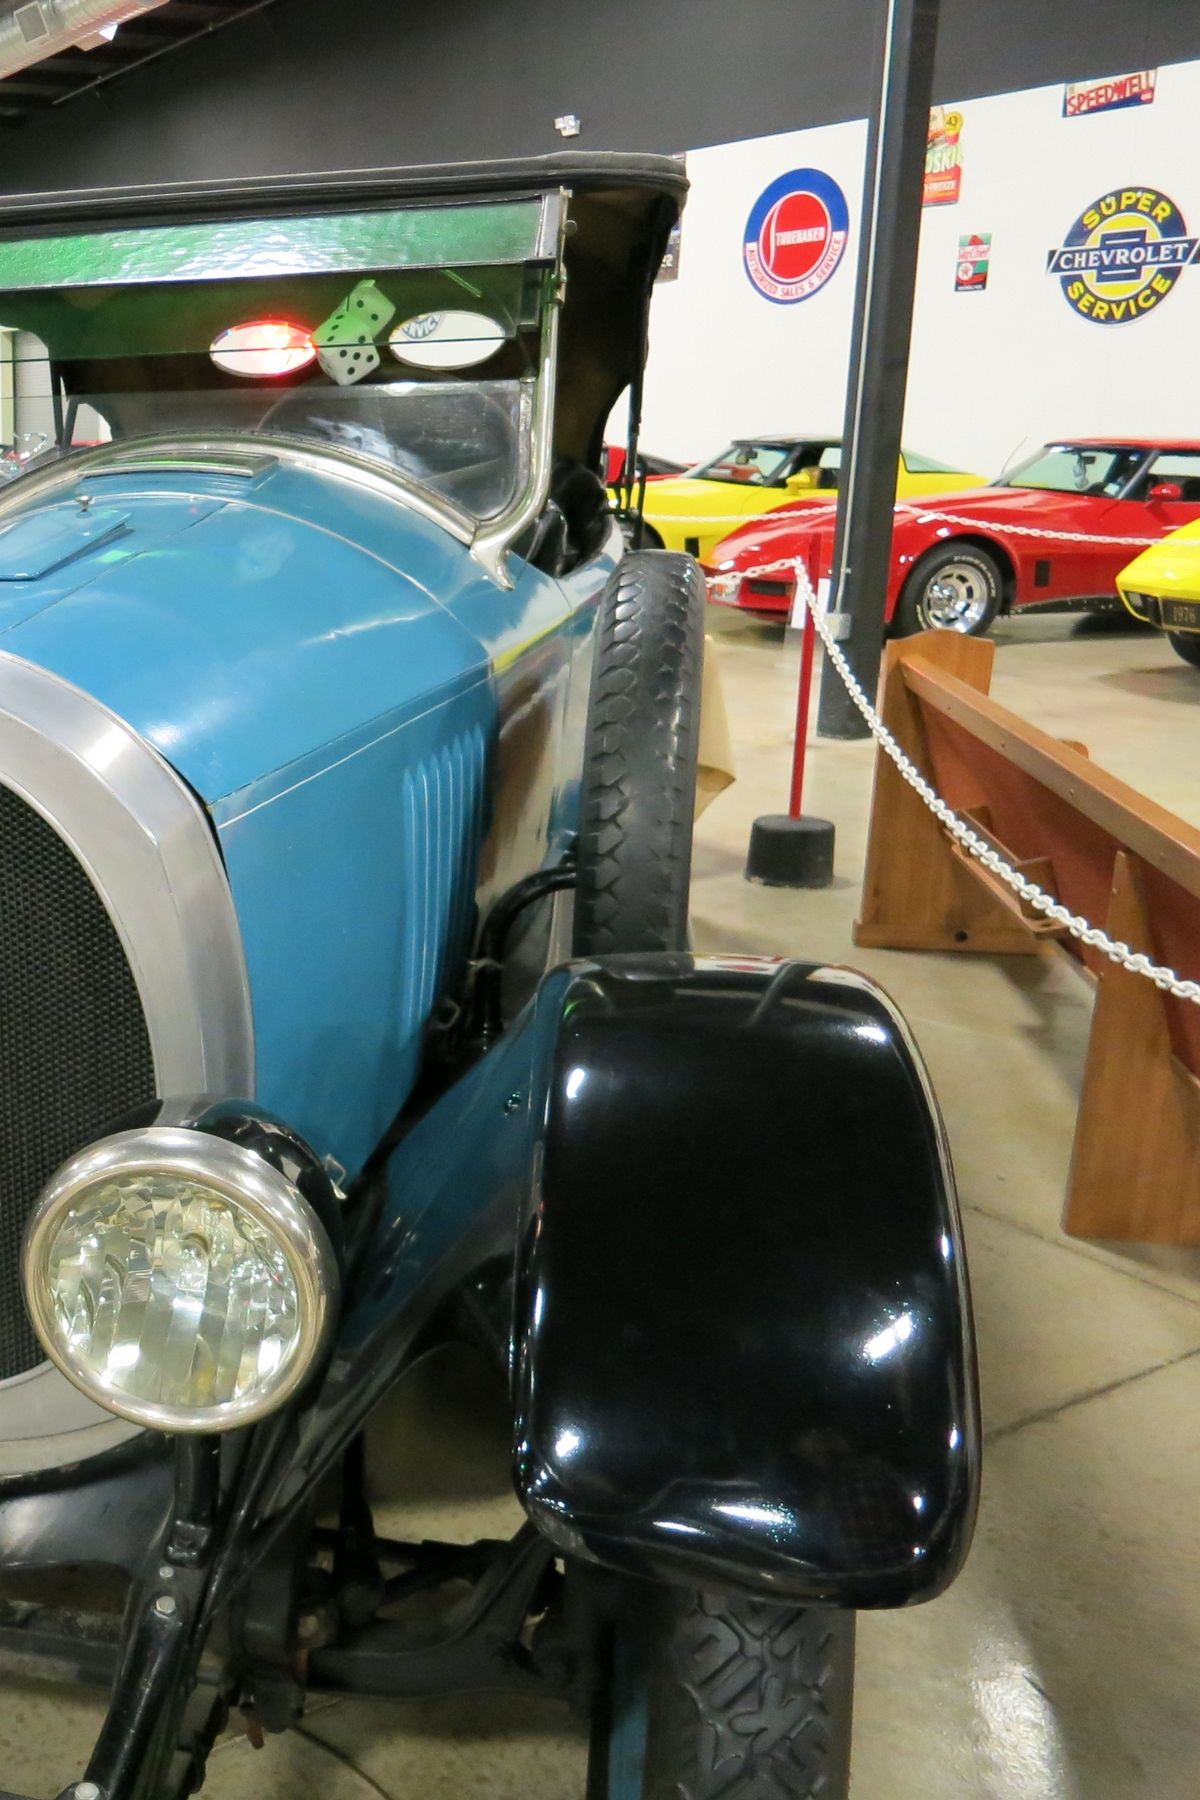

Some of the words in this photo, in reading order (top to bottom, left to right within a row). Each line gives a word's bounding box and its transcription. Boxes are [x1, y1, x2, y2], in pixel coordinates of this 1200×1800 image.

[1067, 71, 1152, 113] SPEEDWELL
[1081, 191, 1173, 231] SUPER
[748, 248, 779, 296] AUTHORIZED
[780, 285, 806, 297] SALES
[816, 238, 842, 282] SERVICE
[1058, 241, 1190, 271] CHEVROLET
[1067, 272, 1174, 322] SERVICE
